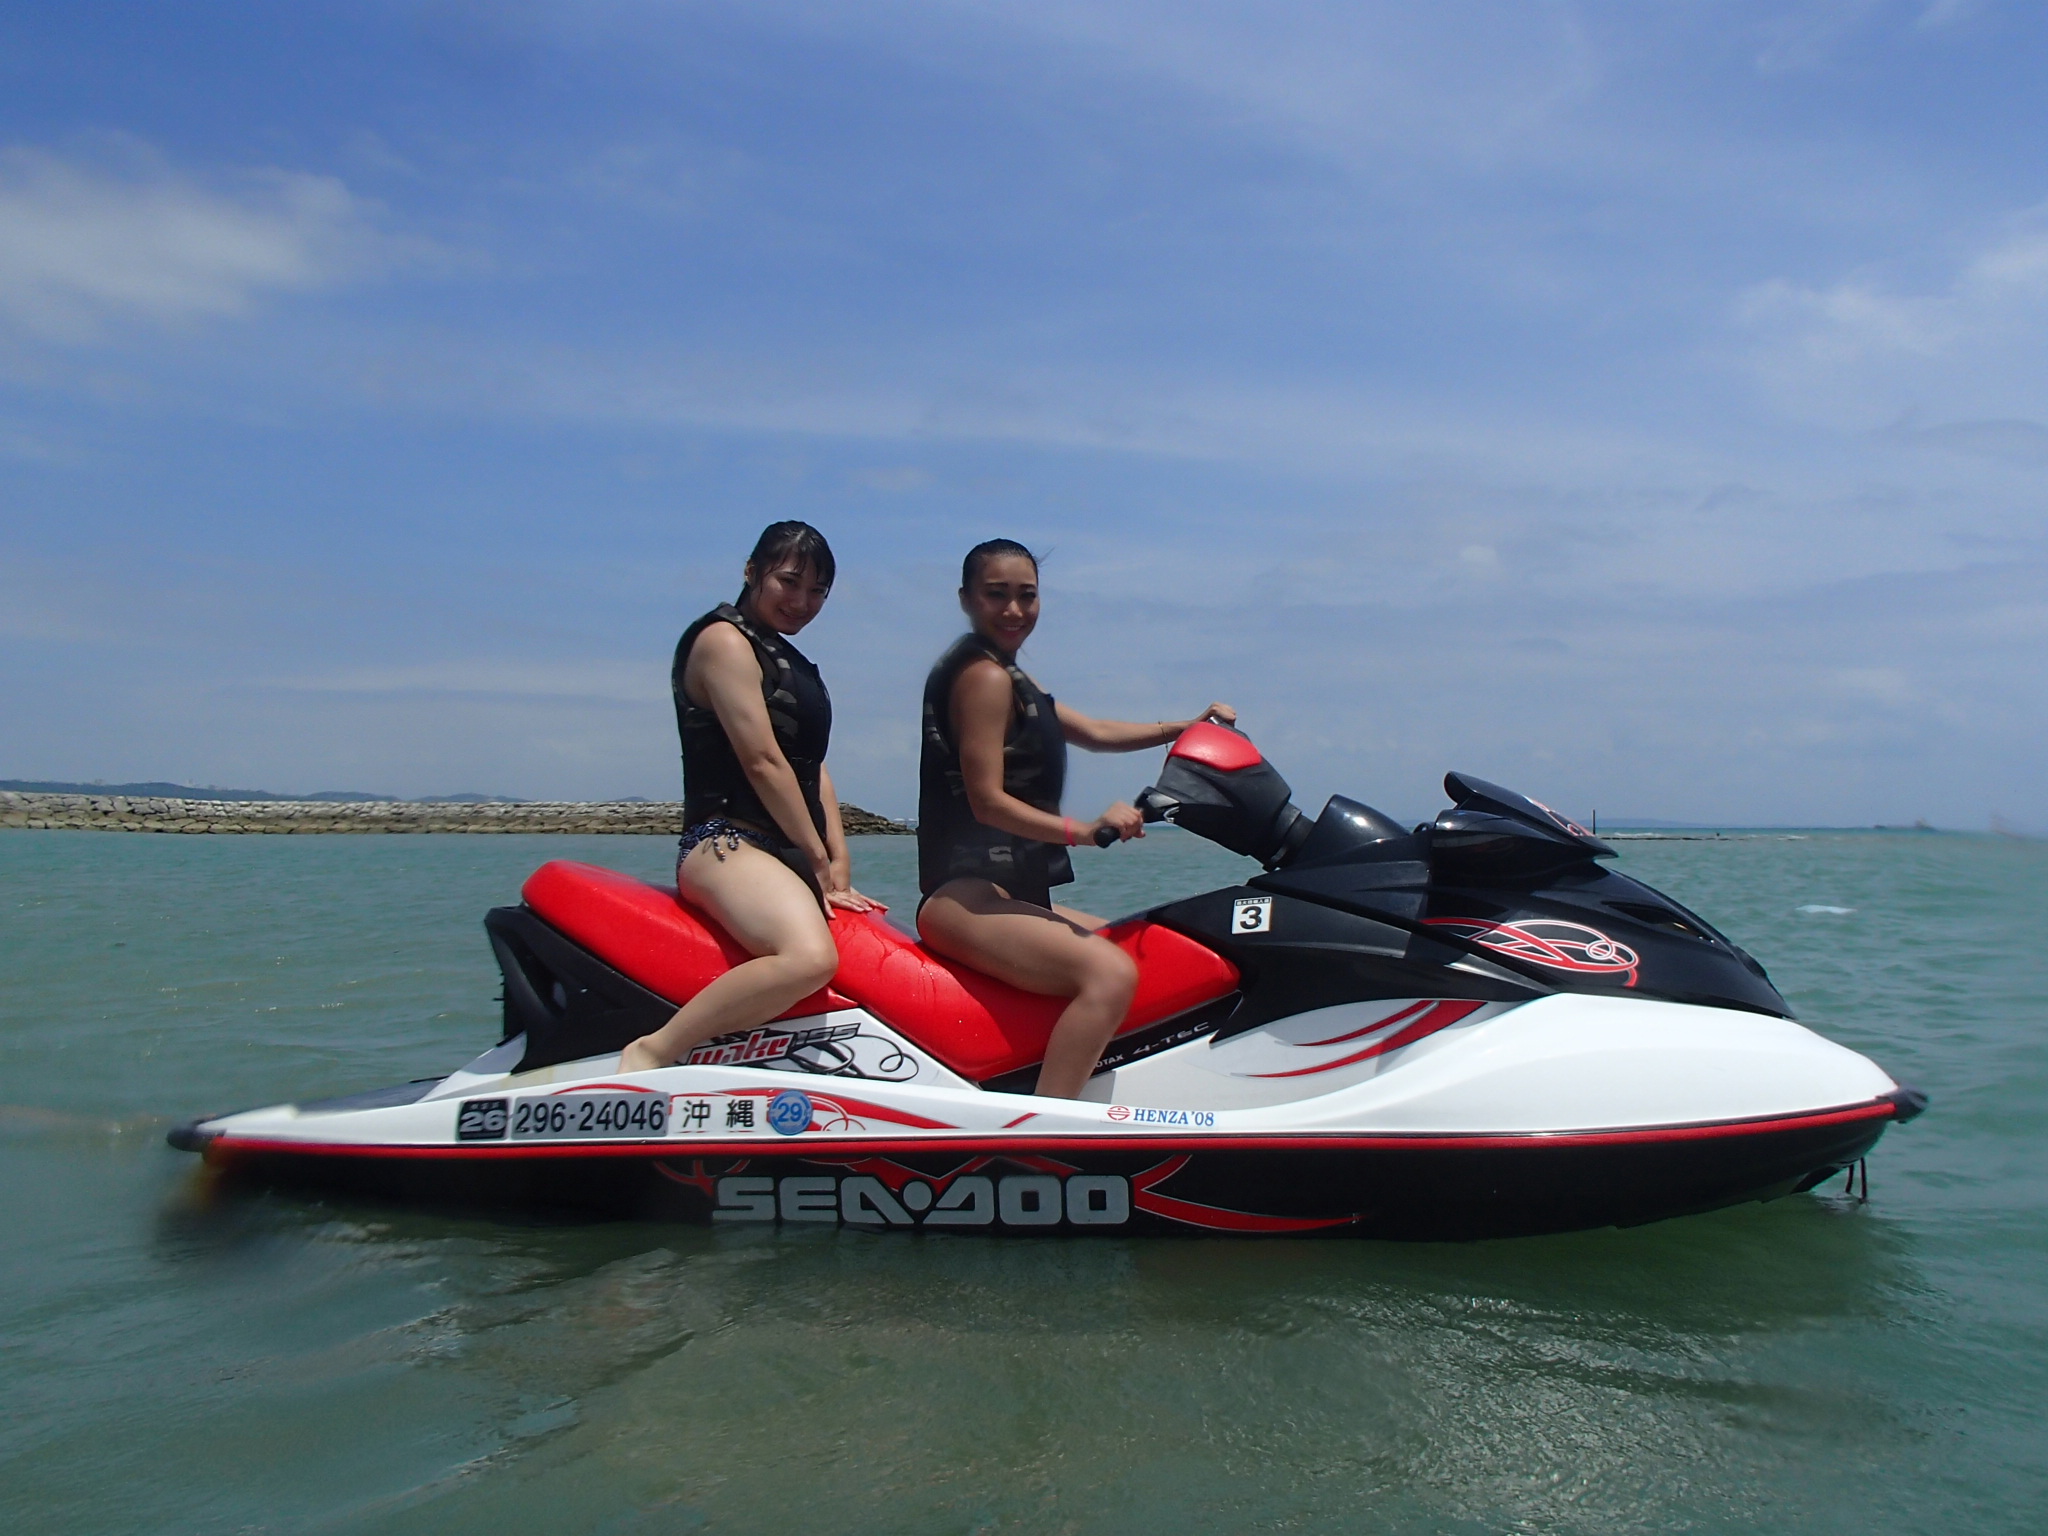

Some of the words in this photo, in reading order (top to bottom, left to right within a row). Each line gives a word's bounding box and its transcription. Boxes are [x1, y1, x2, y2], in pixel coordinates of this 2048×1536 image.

[1240, 905, 1262, 930] 3
[1095, 1053, 1124, 1068] OTAX
[1132, 1021, 1209, 1055] 4-TEC
[460, 1110, 507, 1132] 26
[515, 1099, 665, 1133] 296-24046
[682, 1099, 755, 1128] 沖縄
[777, 1102, 803, 1122] 29
[1133, 1108, 1189, 1125] HENZA
[1191, 1111, 1215, 1127] '08
